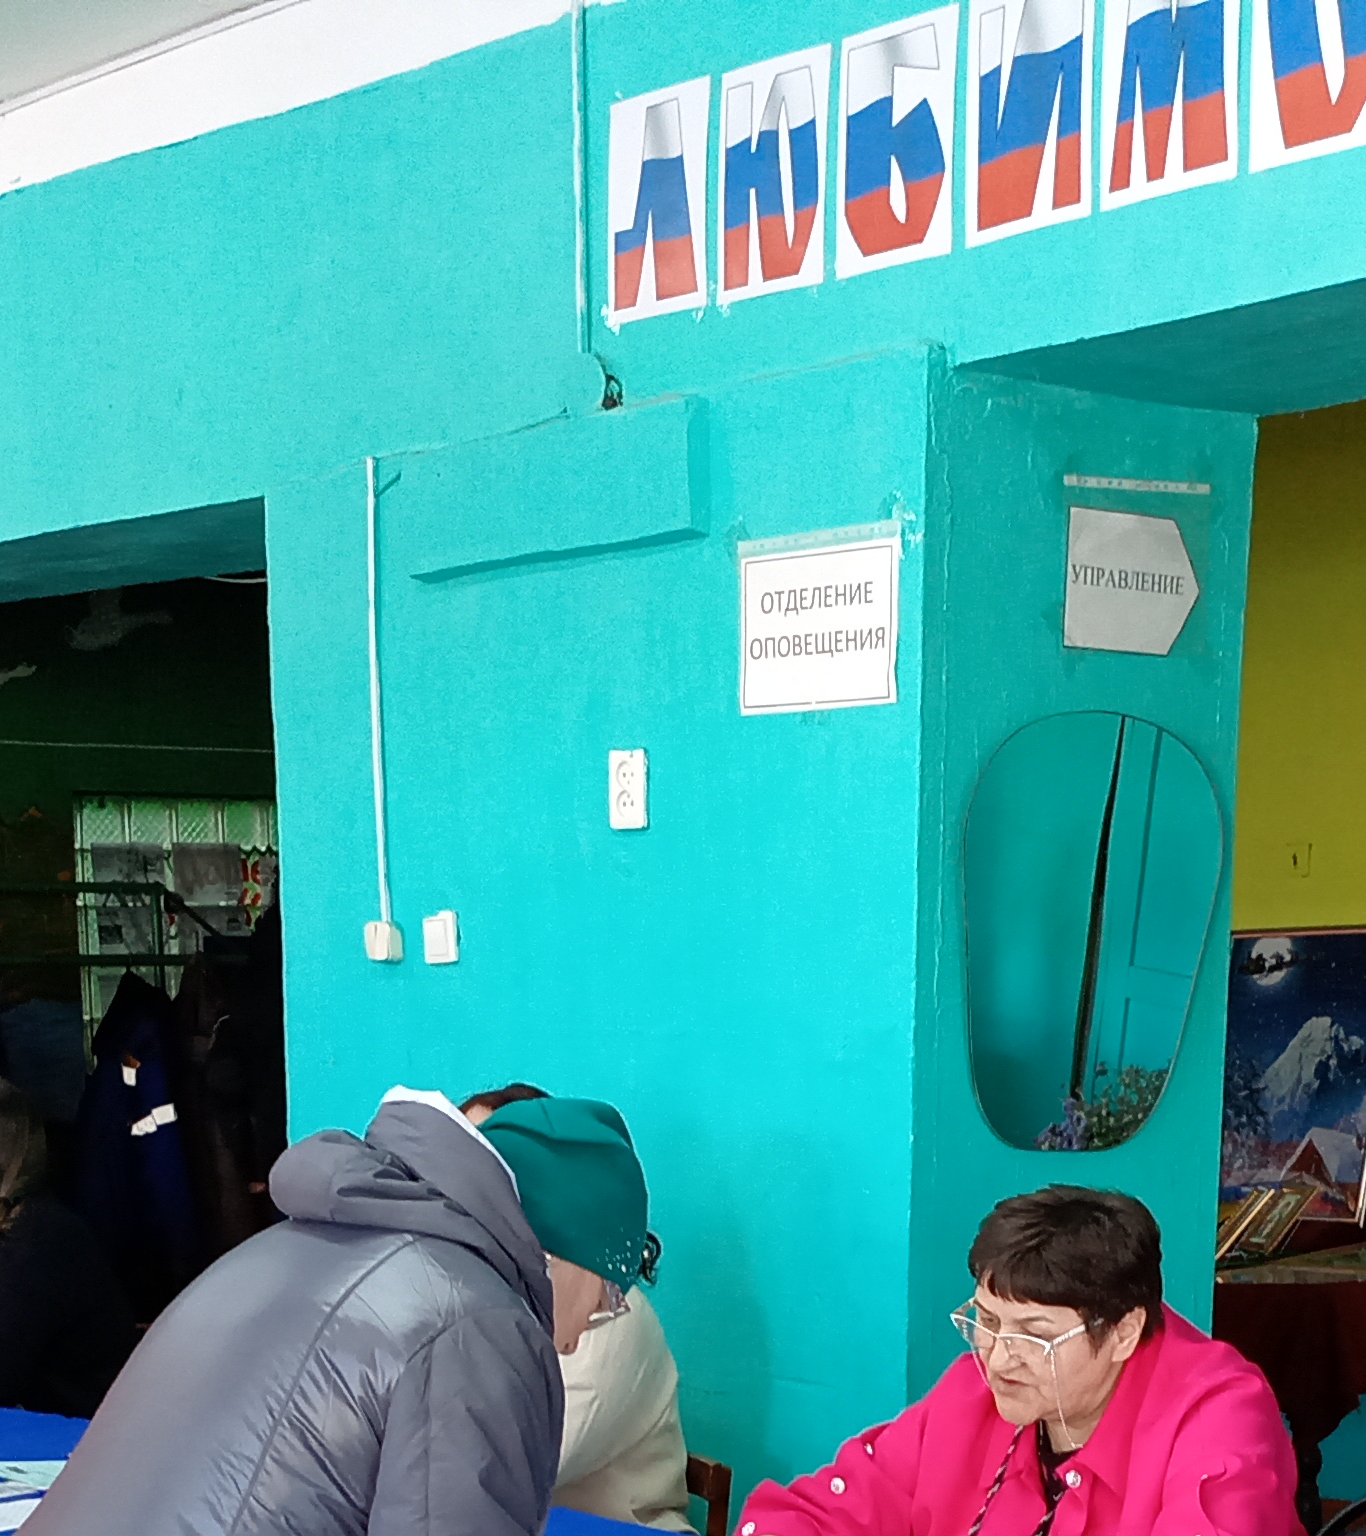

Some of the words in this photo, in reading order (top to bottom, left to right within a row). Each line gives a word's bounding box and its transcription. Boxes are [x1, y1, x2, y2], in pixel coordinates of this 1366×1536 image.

[1071, 563, 1185, 597] УПРАВЛЕНИЕ
[760, 581, 874, 617] ОТДЕЛЕНИЕ
[749, 627, 886, 661] ОПОВЕЩЕНИЯ
